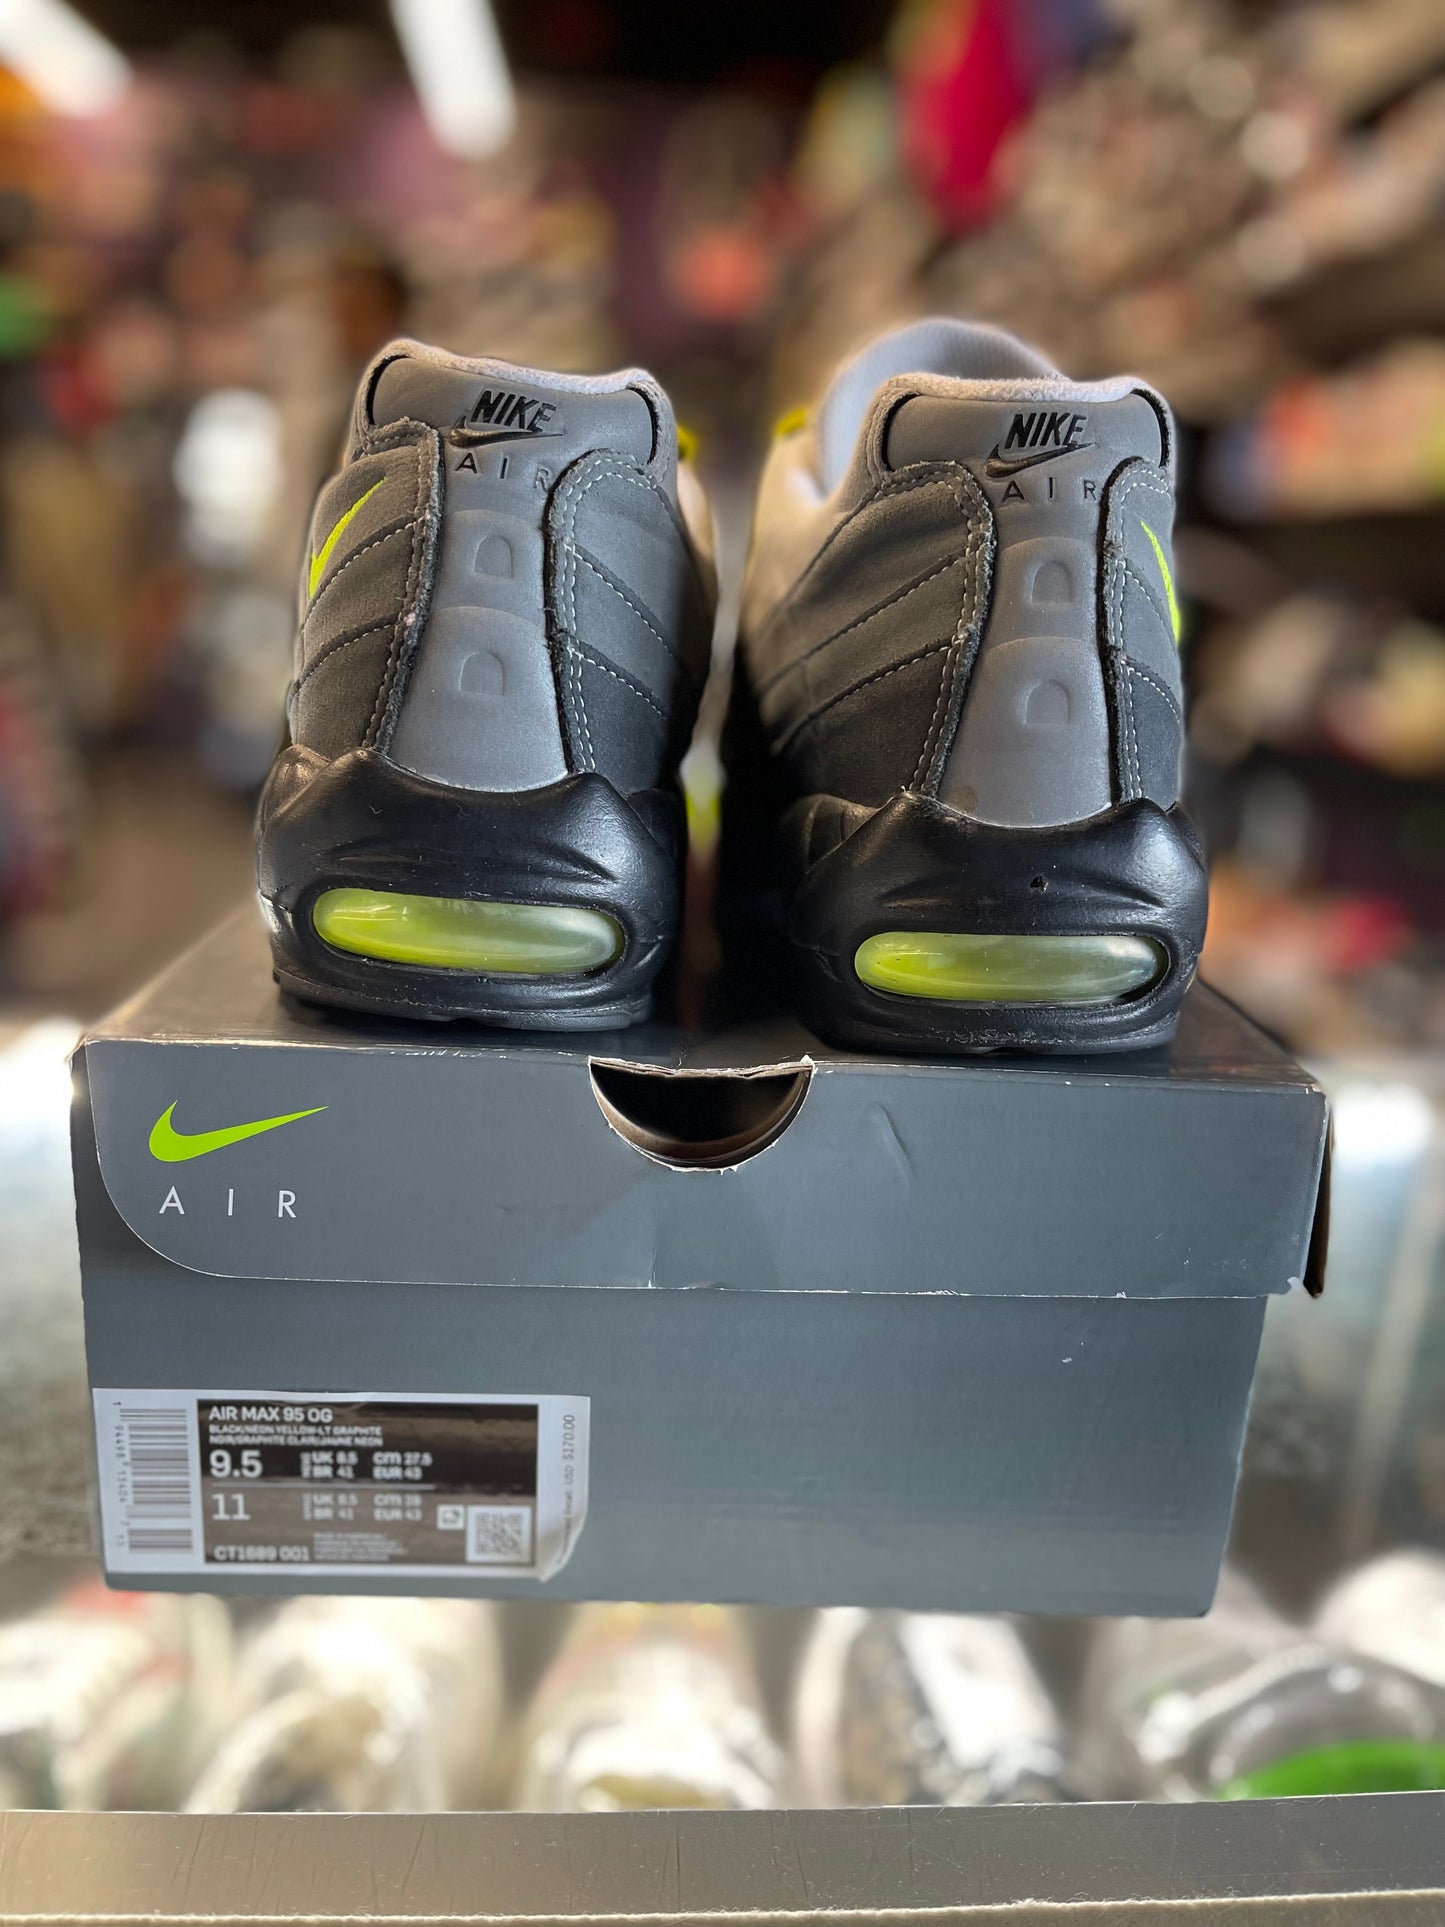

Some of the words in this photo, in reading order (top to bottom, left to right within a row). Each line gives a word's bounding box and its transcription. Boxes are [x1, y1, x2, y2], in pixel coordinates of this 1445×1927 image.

[470, 390, 557, 432] NIKE
[1004, 412, 1087, 450] NIKE
[454, 452, 551, 493] AIR
[1002, 477, 1097, 503] AIR
[158, 1185, 297, 1218] AIR
[208, 1406, 238, 1421] AIR
[241, 1406, 280, 1422] MAX
[283, 1407, 305, 1422] 95
[307, 1408, 333, 1423] OG
[562, 1414, 576, 1461] $170.00
[209, 1450, 263, 1478] 9.5
[312, 1451, 334, 1464] UK
[403, 1452, 433, 1466] 27.5
[372, 1466, 402, 1480] EUR
[211, 1492, 251, 1521] 11
[313, 1493, 334, 1506] UK
[374, 1507, 402, 1521] EUR
[279, 1545, 310, 1561] 001
